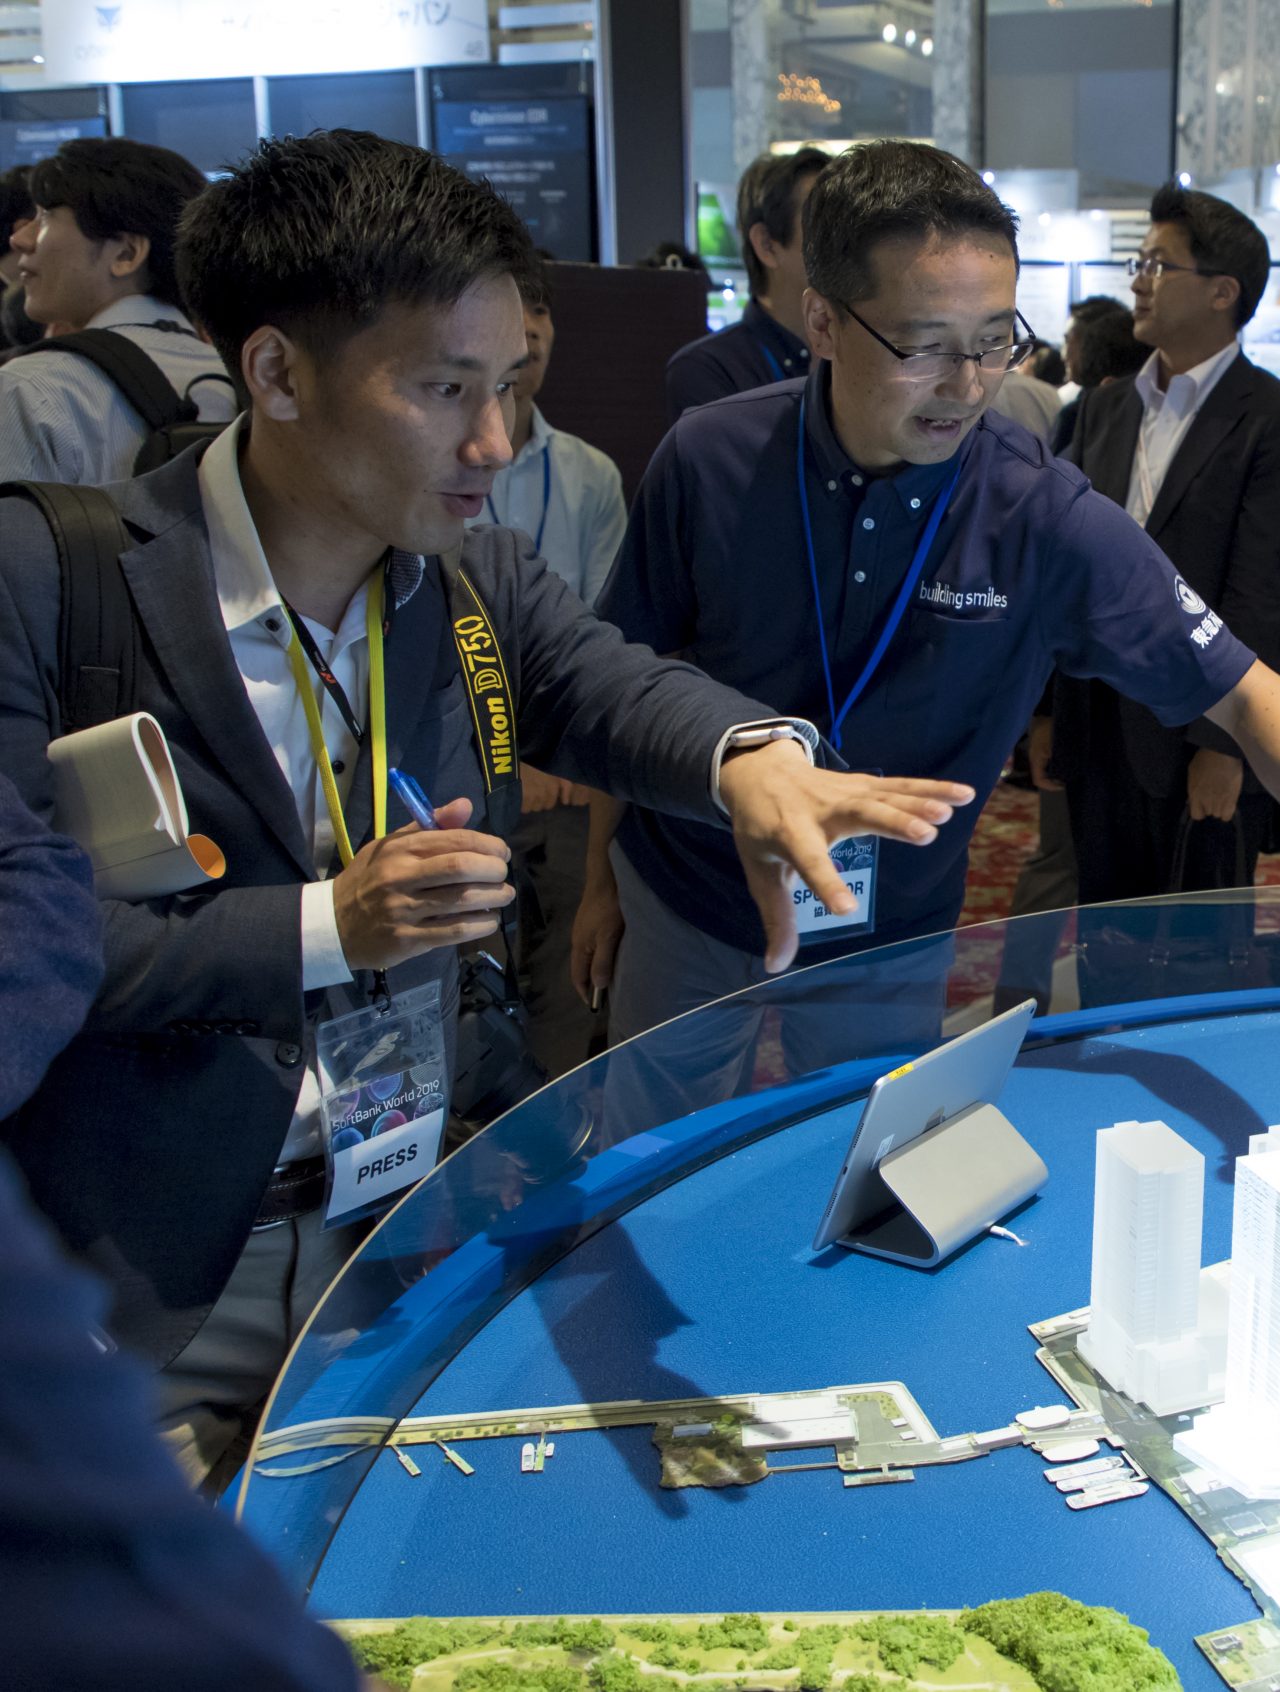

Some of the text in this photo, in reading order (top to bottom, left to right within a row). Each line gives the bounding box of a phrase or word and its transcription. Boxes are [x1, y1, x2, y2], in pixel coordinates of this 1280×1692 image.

[919, 580, 1008, 610] building smiles
[453, 615, 513, 775] Nikon D750
[854, 844, 873, 856] 2019
[332, 1079, 440, 1132] SoftBank World 2019
[357, 1143, 418, 1184] PRESS
